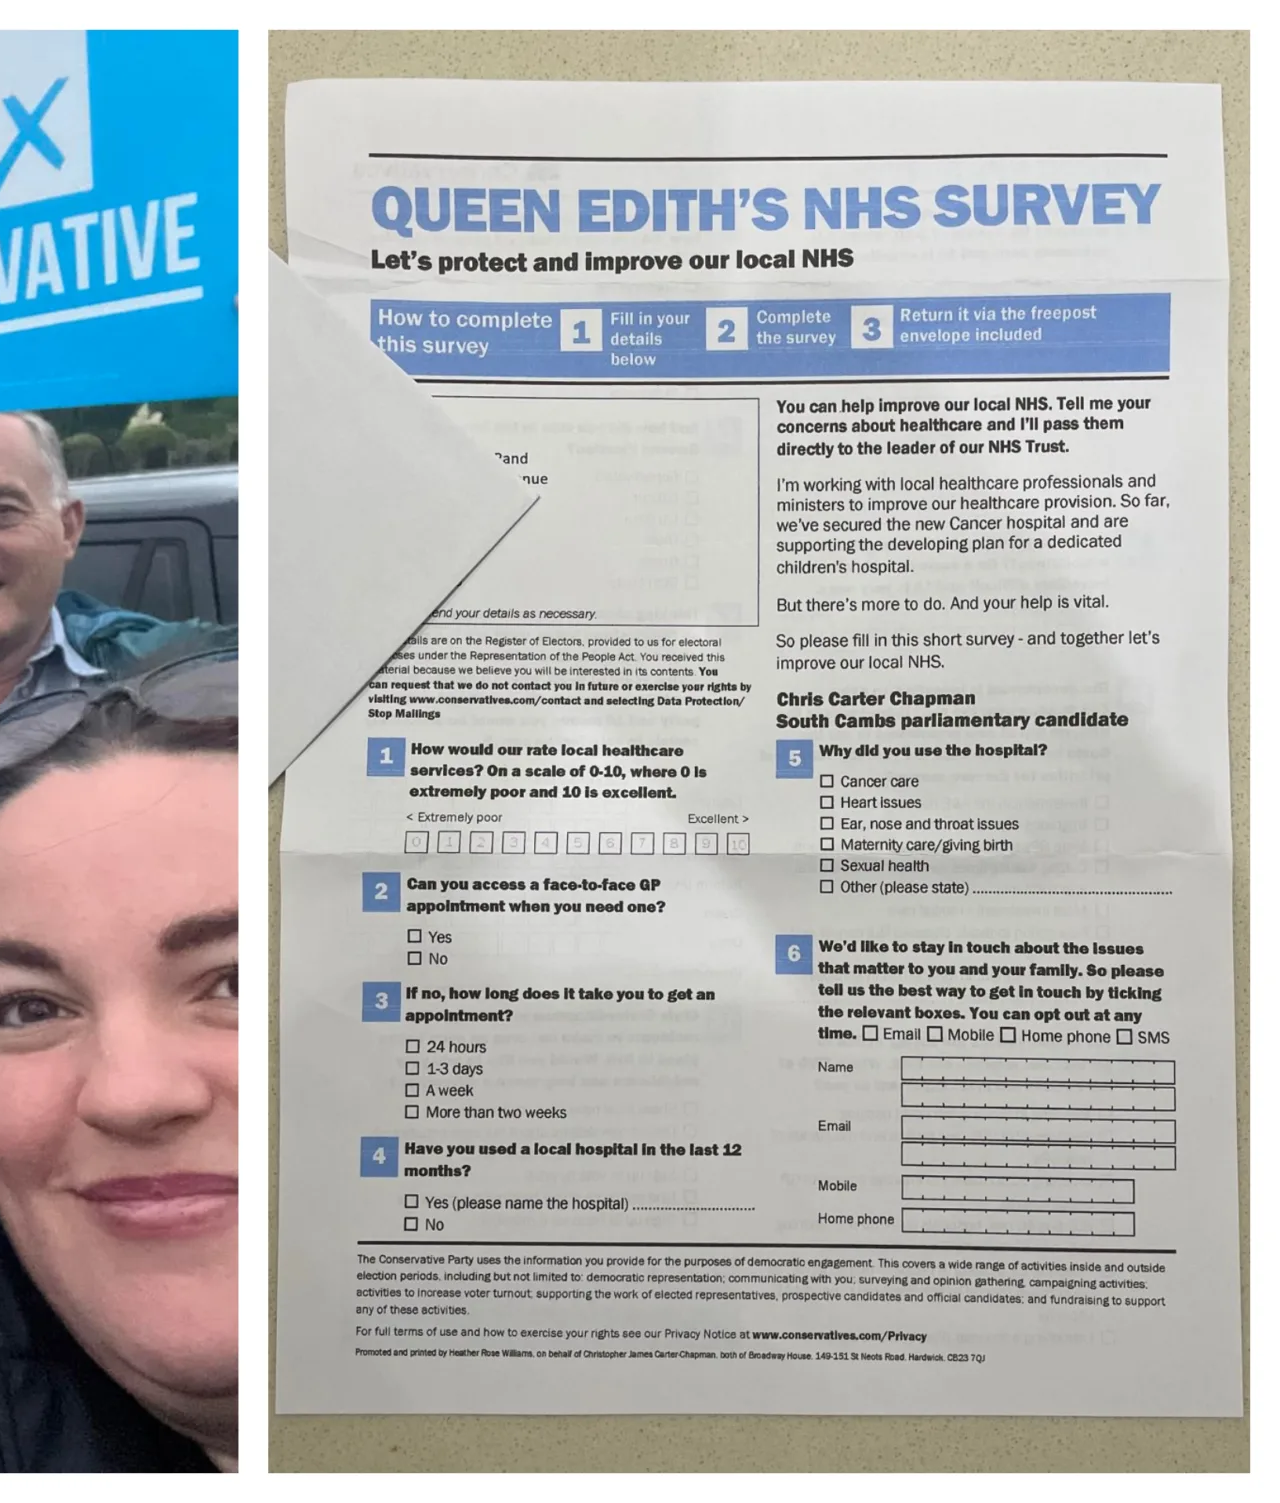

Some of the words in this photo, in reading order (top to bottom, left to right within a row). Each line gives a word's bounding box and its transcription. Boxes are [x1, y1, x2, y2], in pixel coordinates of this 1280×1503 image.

[371, 186, 561, 237] QUEEN
[578, 186, 789, 233] EDITH'S
[804, 185, 921, 231] NHS
[933, 183, 1162, 228] SURVEY
[371, 249, 432, 271] Let's
[438, 251, 527, 275] protect
[533, 252, 579, 272] and
[585, 252, 683, 274] improve
[688, 254, 731, 271] our
[737, 249, 795, 270] local
[802, 248, 855, 269] NHS
[378, 308, 422, 327] How
[429, 309, 451, 328] to
[456, 312, 553, 332] complete
[610, 312, 634, 325] Fill
[639, 312, 653, 325] in
[657, 312, 690, 329] your
[756, 310, 831, 326] Complete
[900, 307, 953, 322] Return
[959, 307, 969, 321] it
[974, 307, 996, 321] via
[1001, 306, 1026, 321] the
[1031, 305, 1097, 322] freepost
[573, 320, 591, 344] 1
[718, 319, 735, 343] 2
[863, 317, 881, 341] 3
[900, 329, 971, 345] envelope
[976, 327, 1042, 342] included
[378, 335, 417, 353] this
[422, 338, 489, 358] survey
[610, 332, 663, 346] details
[756, 331, 782, 344] the
[786, 332, 837, 347] survey
[611, 353, 657, 366] below
[777, 399, 805, 414] You
[810, 401, 837, 414] can
[840, 398, 875, 416] help
[879, 397, 941, 415] improve
[945, 400, 971, 412] our
[974, 396, 1011, 412] local
[1016, 396, 1053, 411] NHS.
[1057, 395, 1085, 411] Tell
[1090, 398, 1114, 411] me
[1118, 398, 1152, 413] your
[777, 421, 848, 434] concerns
[852, 418, 896, 433] about
[900, 417, 983, 433] healthcare
[987, 417, 1016, 432] and
[1021, 416, 1039, 431] I'll
[1044, 419, 1080, 434] pass
[1084, 415, 1124, 431] them
[777, 441, 835, 459] directly
[838, 441, 854, 456] to
[857, 441, 883, 456] the
[887, 440, 937, 455] leader
[940, 439, 956, 455] of
[960, 442, 985, 455] our
[989, 439, 1022, 454] NHS
[1026, 439, 1070, 453] Trust.
[522, 475, 548, 484] nue
[368, 693, 407, 706] visiting
[409, 694, 582, 707] www.conservatives.com/contact
[584, 695, 605, 706] and
[606, 695, 655, 708] selecting
[658, 695, 683, 707] Data
[685, 695, 746, 708] Protection/
[777, 691, 825, 707] Chris
[828, 691, 886, 707] Carter
[890, 690, 976, 709] Chapman
[368, 708, 393, 721] Stop
[396, 708, 441, 721] Mailings
[776, 713, 830, 729] South
[835, 713, 897, 729] Cambs
[901, 712, 1031, 731] parliamentary
[1035, 711, 1129, 728] candidate
[380, 747, 393, 764] 1
[410, 743, 440, 756] How
[447, 743, 489, 756] would
[496, 745, 520, 756] our
[525, 744, 555, 756] rate
[561, 744, 597, 757] local
[602, 744, 685, 757] healthcare
[788, 750, 801, 767] 5
[819, 744, 853, 760] Why
[855, 743, 880, 757] did
[883, 746, 911, 760] you
[915, 746, 943, 757] use
[946, 743, 972, 757] the
[976, 743, 1048, 759] hospital?
[410, 763, 485, 777] services?
[487, 764, 508, 777] On
[512, 767, 521, 777] a
[526, 764, 567, 778] scale
[570, 764, 587, 778] of
[590, 765, 627, 781] 0-10,
[630, 765, 678, 779] where
[681, 765, 691, 779] 0
[694, 765, 707, 779] is
[841, 775, 887, 788] Cancer
[891, 777, 920, 788] care
[410, 785, 487, 801] extremely
[490, 787, 527, 801] poor
[530, 785, 558, 799] and
[563, 785, 582, 799] 10
[585, 785, 599, 799] is
[602, 785, 677, 799] excellent.
[418, 811, 474, 825] Extremely
[477, 813, 503, 825] poor
[688, 813, 740, 825] Excellent
[374, 882, 388, 900] 2
[407, 877, 437, 891] Can
[440, 879, 469, 893] you
[472, 880, 527, 891] access
[530, 880, 540, 891] a
[543, 877, 637, 892] face-to-face
[640, 878, 661, 892] GP
[407, 899, 506, 915] appointment
[509, 899, 551, 913] when
[554, 902, 582, 915] you
[586, 900, 624, 913] need
[627, 900, 667, 913] one?
[428, 930, 453, 944] Yes
[430, 952, 449, 966] No
[818, 1061, 854, 1073] Name
[818, 1119, 851, 1132] Email
[818, 1179, 858, 1192] Mobile
[818, 1212, 855, 1225] Home
[858, 1212, 895, 1227] phone
[356, 1305, 375, 1316] any
[377, 1304, 388, 1315] of
[390, 1304, 419, 1316] these
[422, 1304, 470, 1316] activities.
[753, 1329, 928, 1343] www.conservatives.com/Privacy
